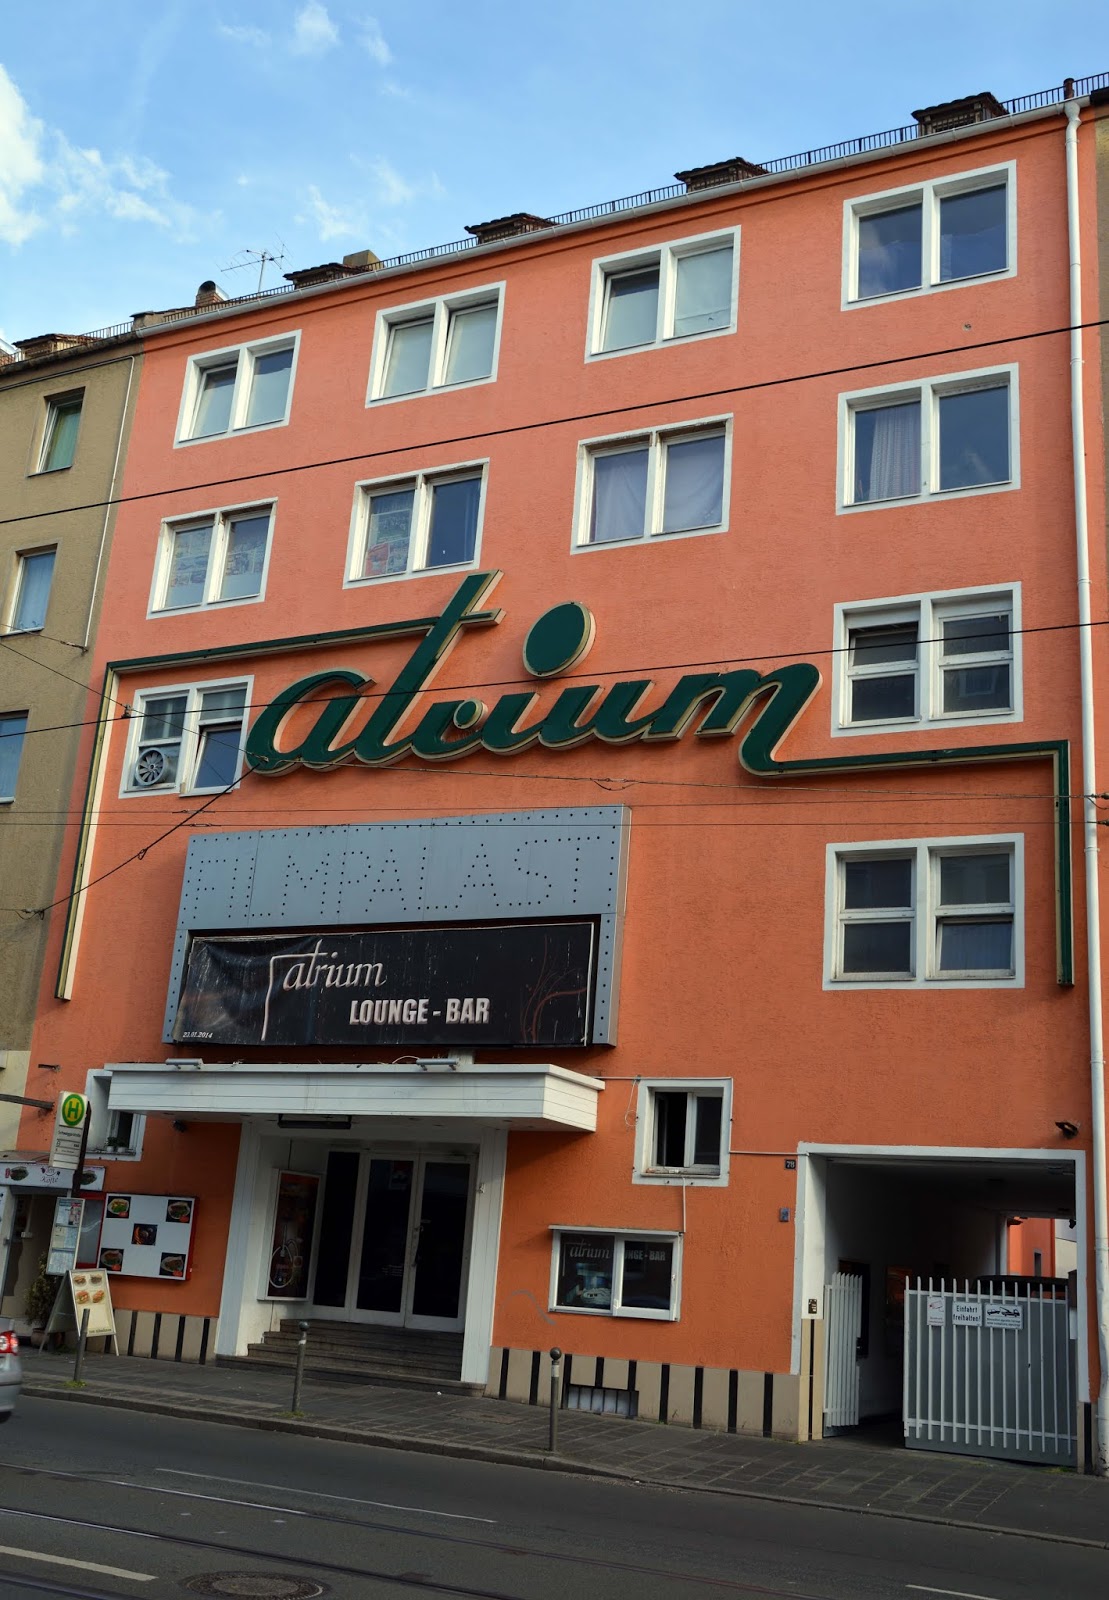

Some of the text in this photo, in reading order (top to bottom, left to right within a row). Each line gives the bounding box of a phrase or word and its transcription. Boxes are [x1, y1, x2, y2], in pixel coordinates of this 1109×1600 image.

[245, 569, 823, 779] atrium
[281, 939, 388, 992] atrium
[349, 999, 429, 1026] LOUNGE
[445, 997, 490, 1025] BAR
[786, 1160, 795, 1168] 78
[624, 1249, 644, 1261] UNGE
[649, 1250, 666, 1262] BAR
[956, 1305, 978, 1313] Einfahrt
[953, 1313, 981, 1322] freihalten!
